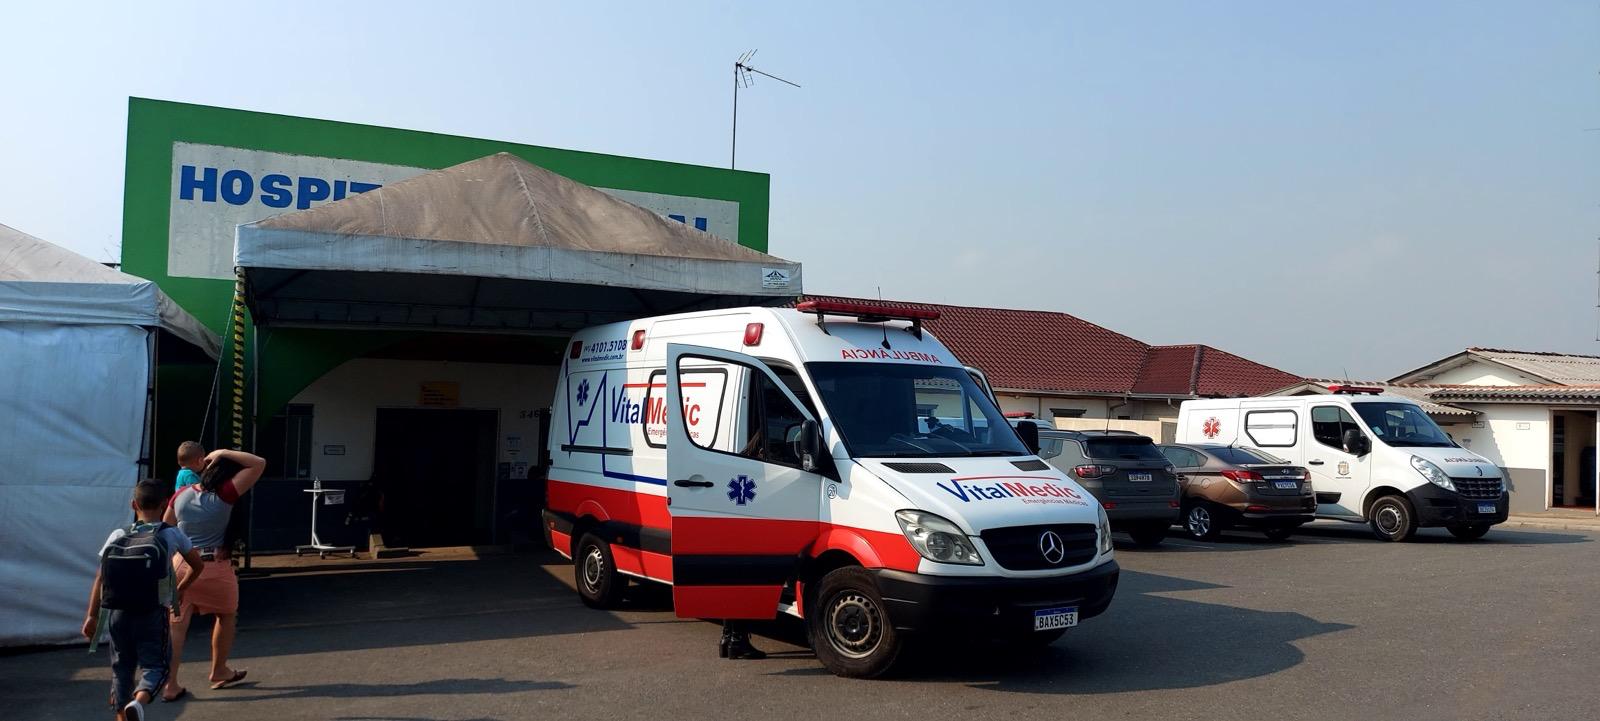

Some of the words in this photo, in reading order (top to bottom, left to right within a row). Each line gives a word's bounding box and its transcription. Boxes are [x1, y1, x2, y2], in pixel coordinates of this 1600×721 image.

[591, 340, 627, 353] 4101.5108
[612, 384, 701, 426] VitalMic
[936, 480, 1082, 502] VitalMedic
[1040, 614, 1074, 629] BAX5C53
